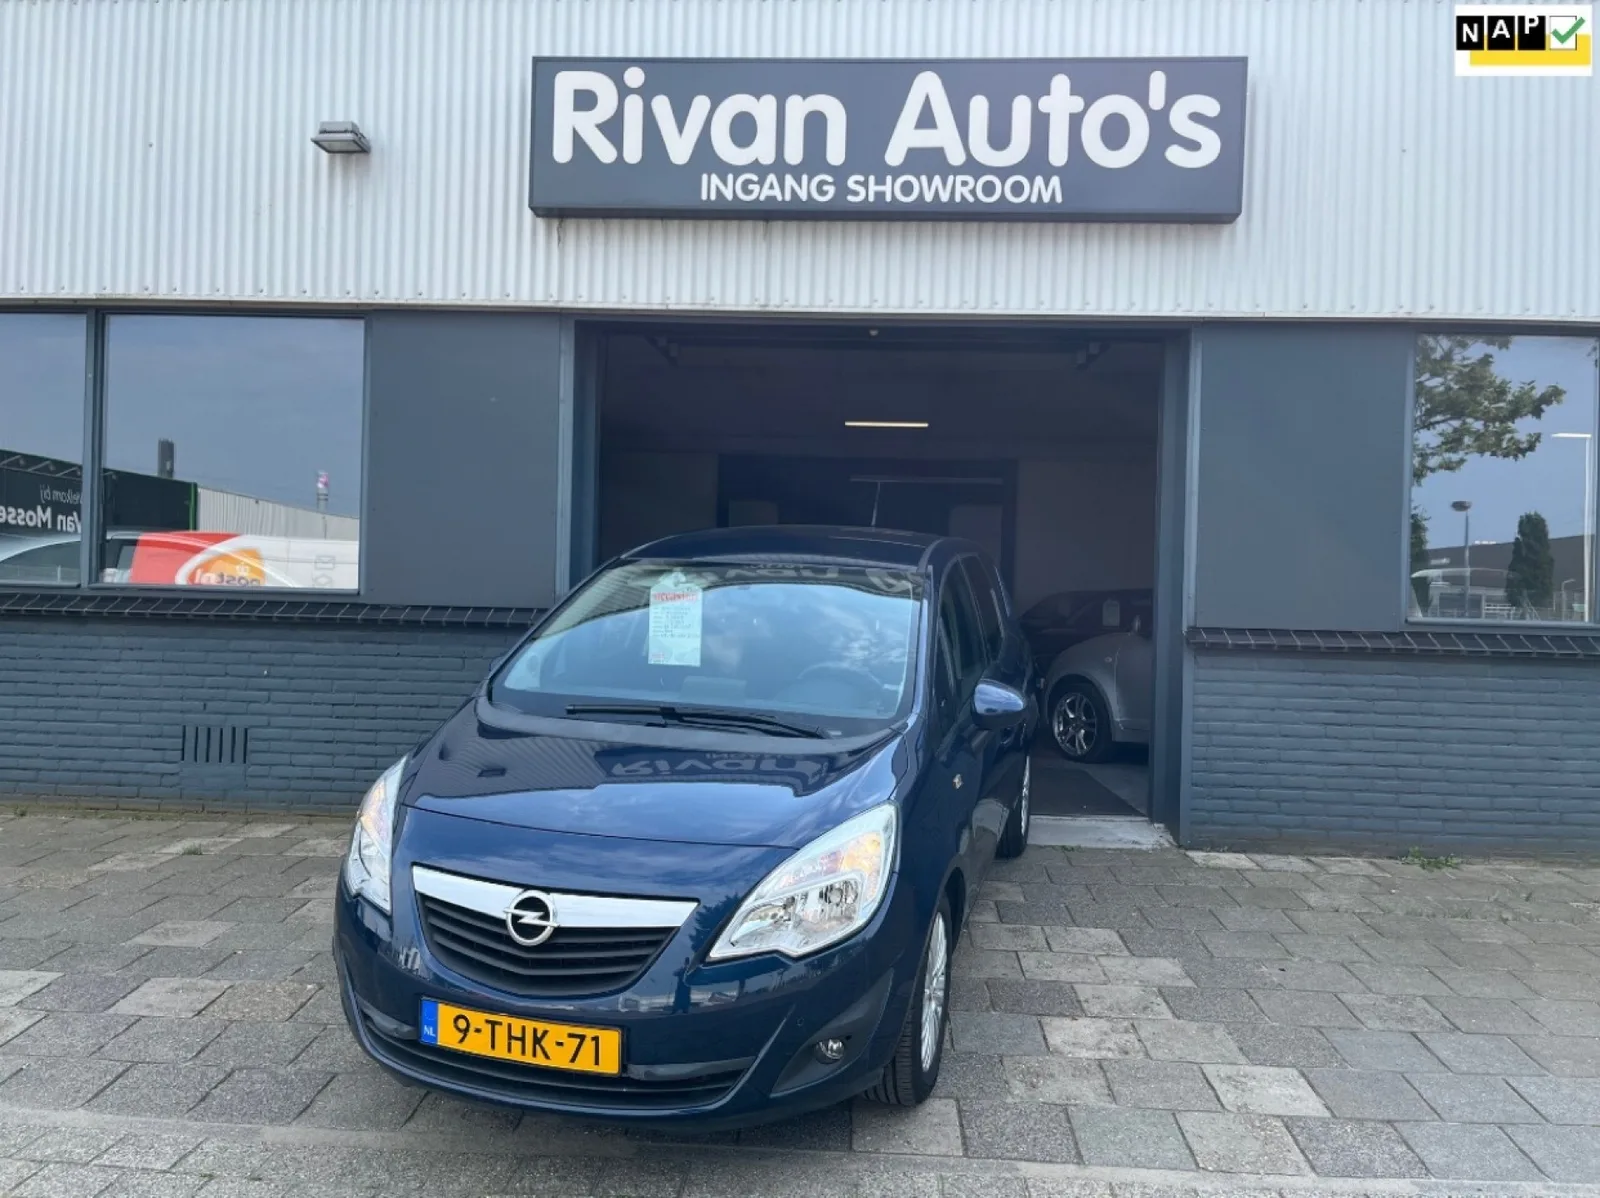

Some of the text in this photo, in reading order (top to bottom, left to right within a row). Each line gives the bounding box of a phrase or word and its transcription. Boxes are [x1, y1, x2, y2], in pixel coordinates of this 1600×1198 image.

[552, 67, 1222, 168] Rivan Auto's
[700, 173, 1063, 204] INGANG SHOWROOM
[423, 1024, 436, 1037] NL
[452, 1014, 600, 1066] 9-THK-71
